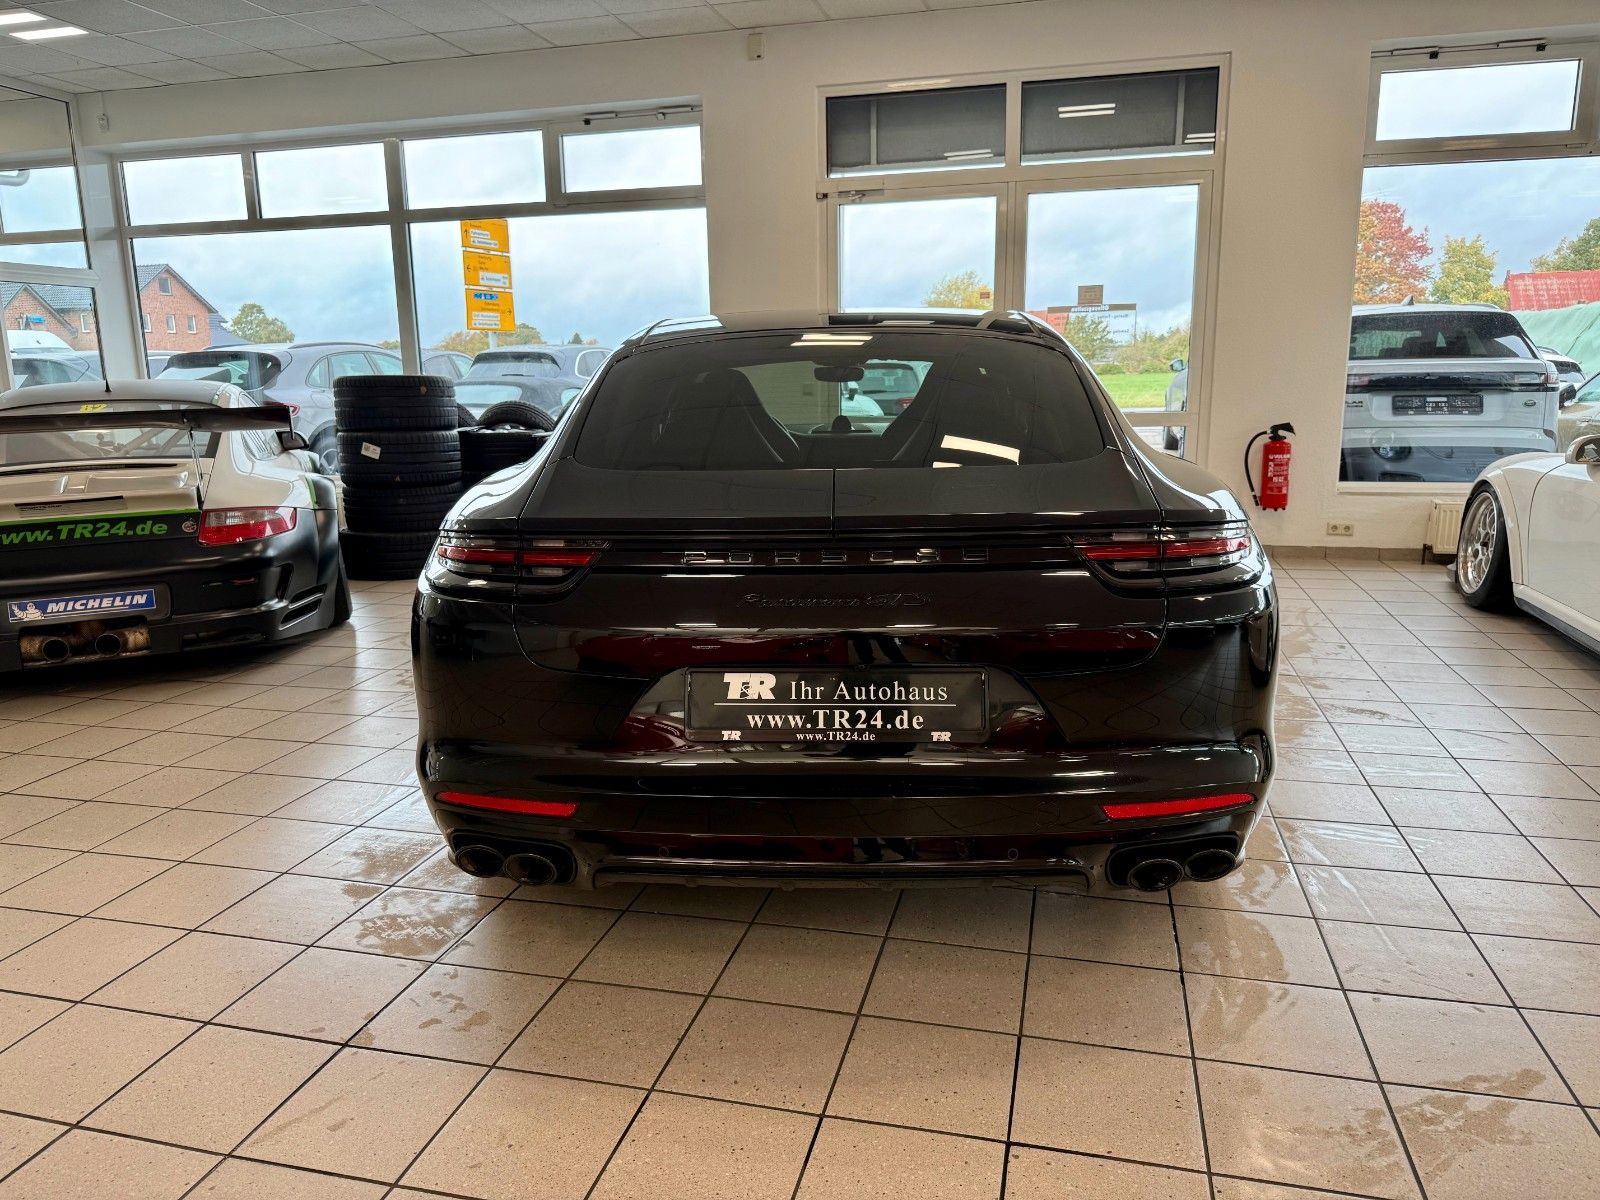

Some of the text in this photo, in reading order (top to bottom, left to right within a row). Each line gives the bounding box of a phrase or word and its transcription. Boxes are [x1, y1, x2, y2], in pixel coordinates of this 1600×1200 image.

[0, 521, 168, 545] ww.TR24.de
[682, 547, 989, 564] PORSCHE
[47, 593, 148, 613] MICHELIN
[789, 681, 825, 701] Ihr
[834, 681, 949, 701] Autohaus
[747, 709, 925, 730] www.TR24.de
[796, 731, 876, 742] www.TR24.de
